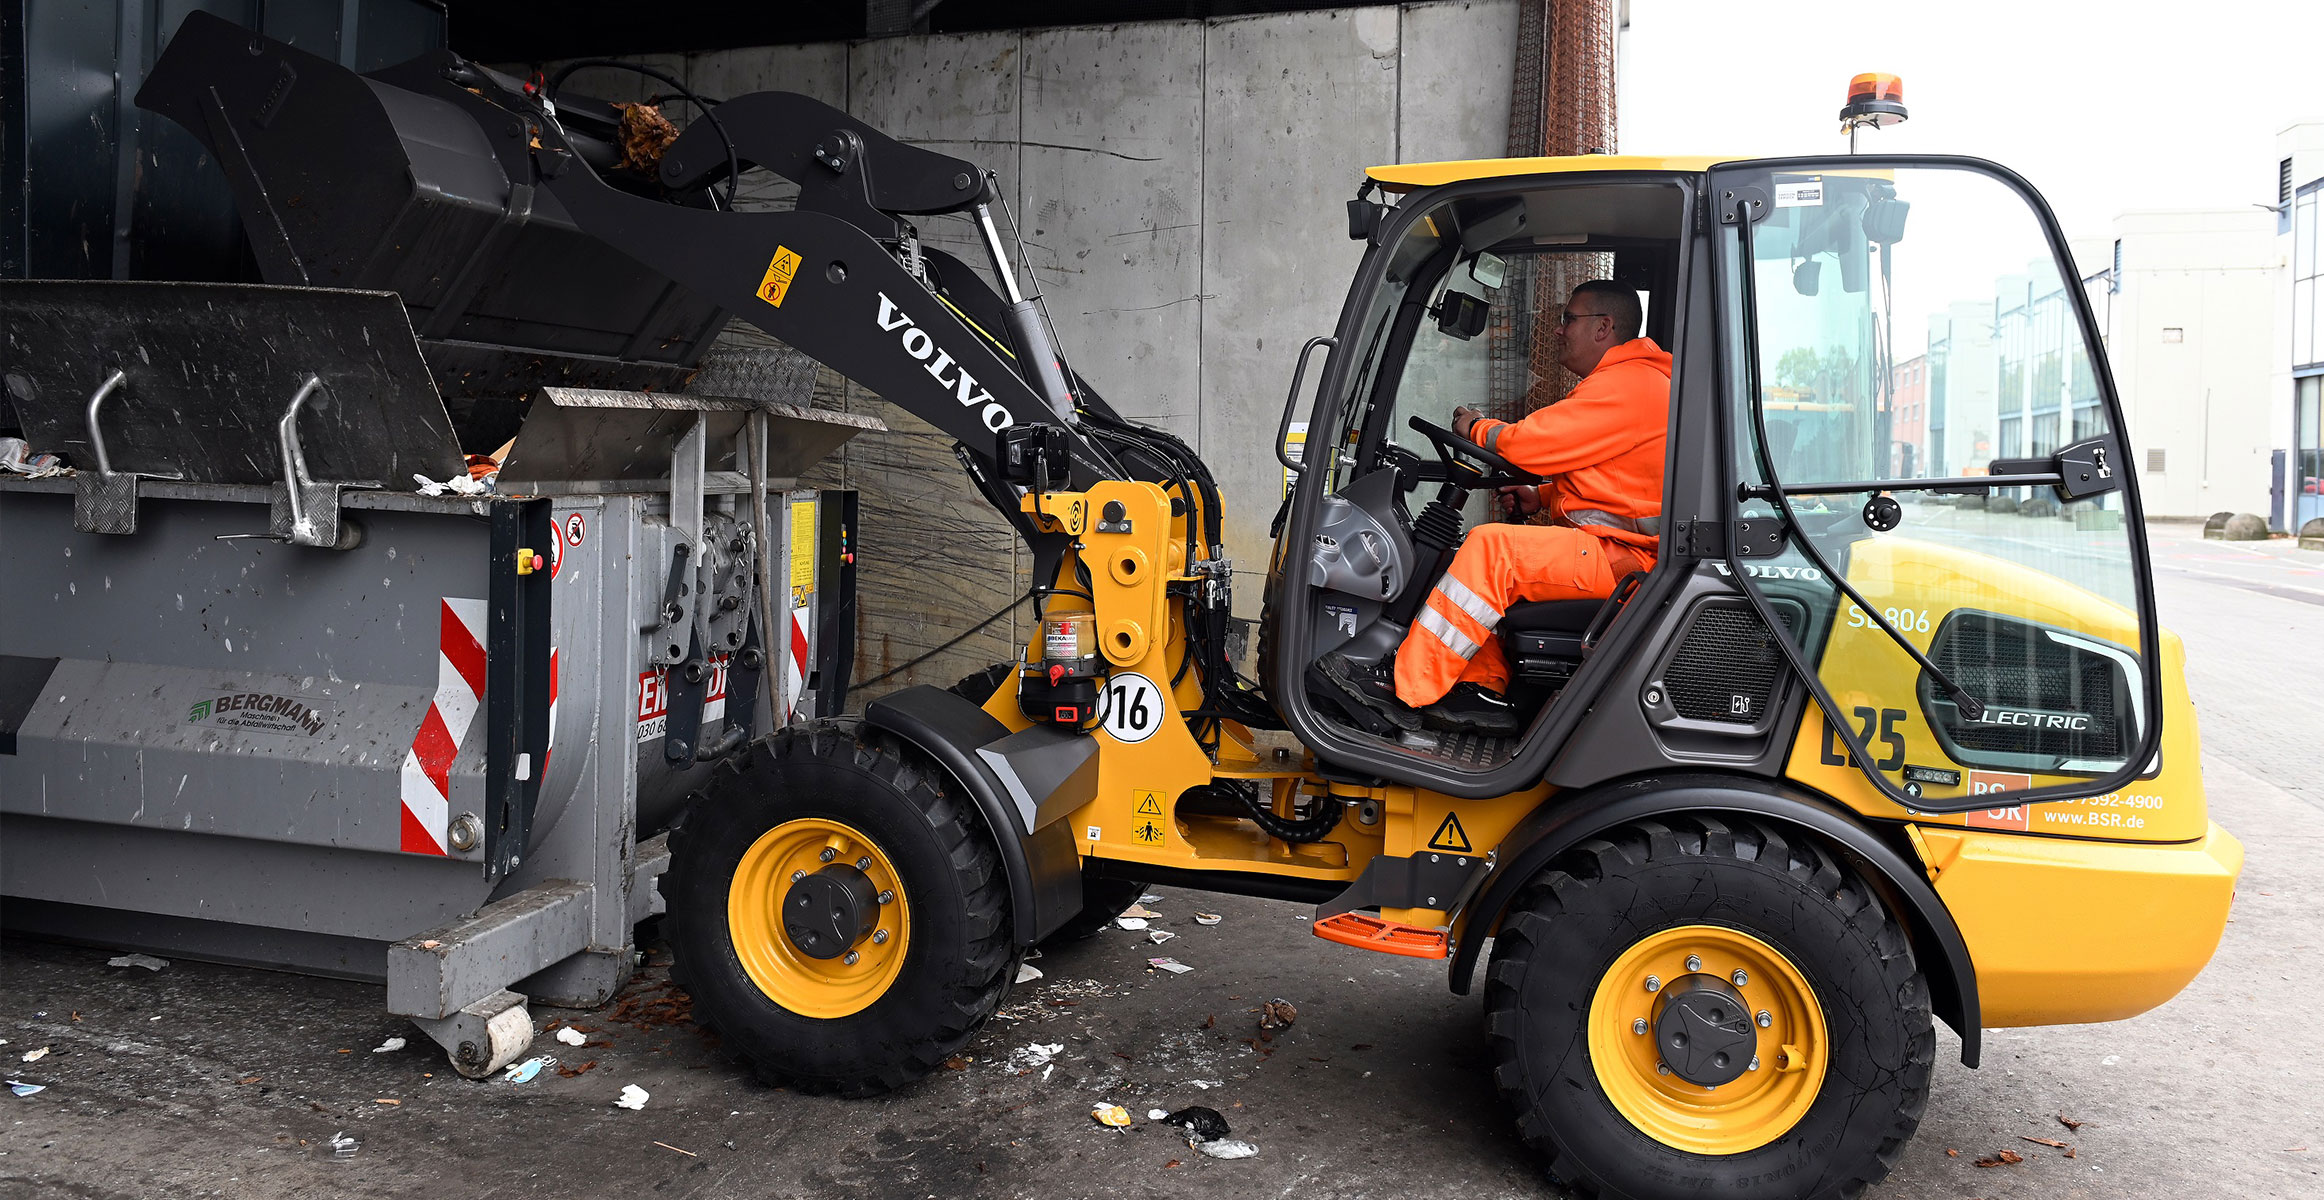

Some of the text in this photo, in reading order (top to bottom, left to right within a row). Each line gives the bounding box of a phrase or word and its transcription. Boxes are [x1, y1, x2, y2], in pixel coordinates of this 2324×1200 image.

[877, 291, 1014, 434] VOLVO
[215, 693, 325, 736] BERGMANN
[1113, 685, 1149, 731] 16
[1965, 710, 2088, 730] LECTRIC
[637, 721, 655, 739] 030
[2044, 811, 2145, 828] www.BSR.de
